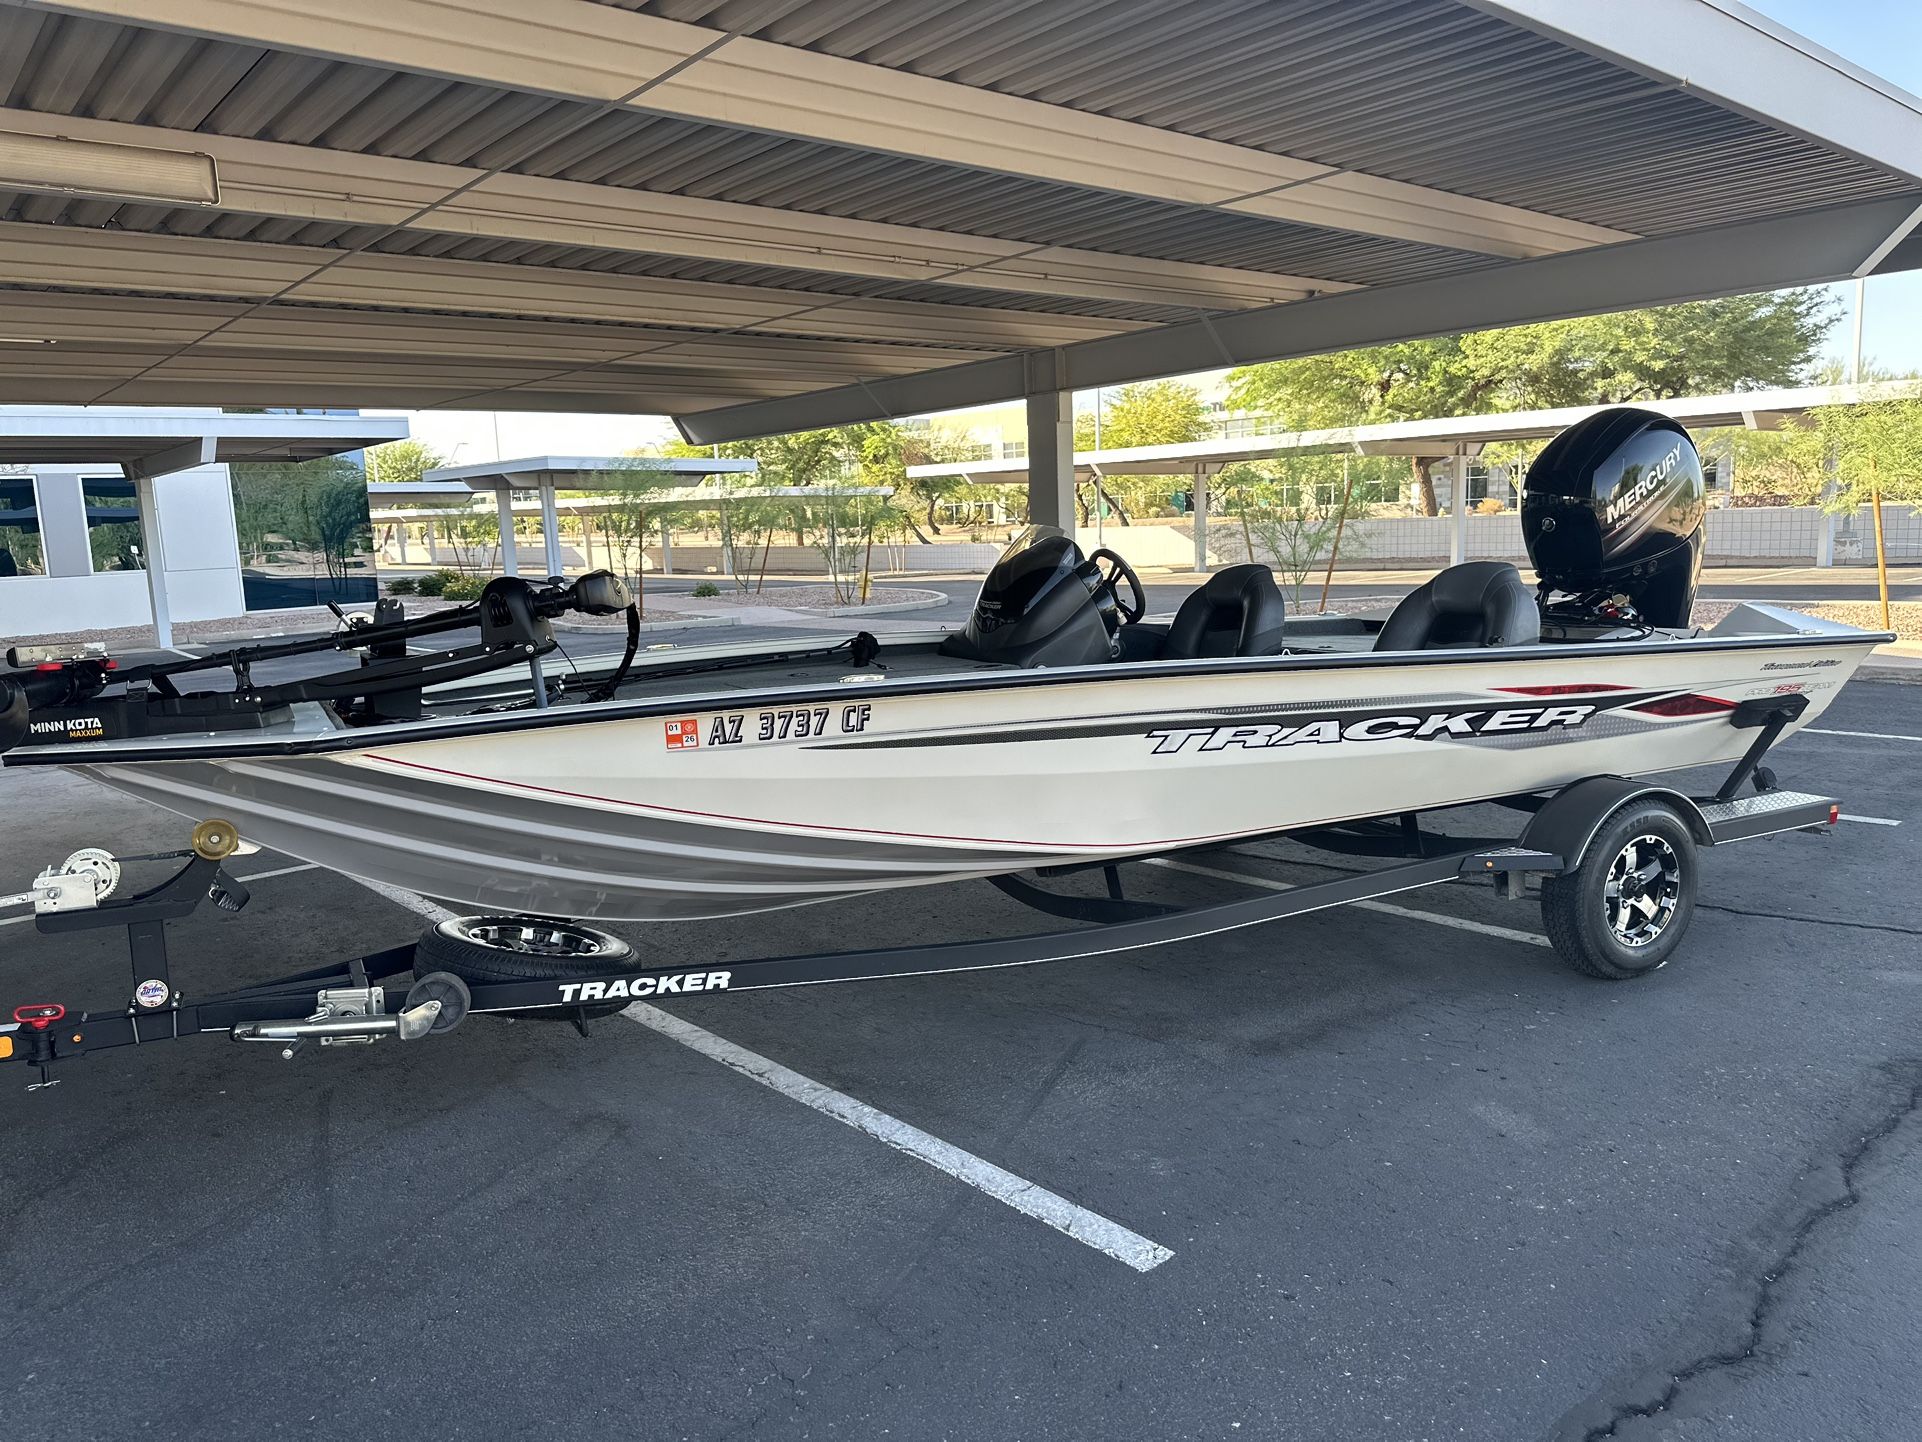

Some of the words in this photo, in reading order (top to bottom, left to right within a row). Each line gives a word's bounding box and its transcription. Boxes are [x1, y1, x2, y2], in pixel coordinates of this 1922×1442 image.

[1606, 442, 1681, 524] MERCURY
[30, 720, 65, 734] MINN
[66, 717, 102, 731] KOTA
[69, 728, 103, 738] MAXXUM
[668, 724, 678, 732] 01
[708, 715, 744, 745] AZ
[758, 708, 829, 741] 3737
[841, 704, 871, 733] CF
[1147, 704, 1600, 755] TRACKER
[685, 735, 695, 743] 26
[558, 971, 732, 1002] TRACKER
